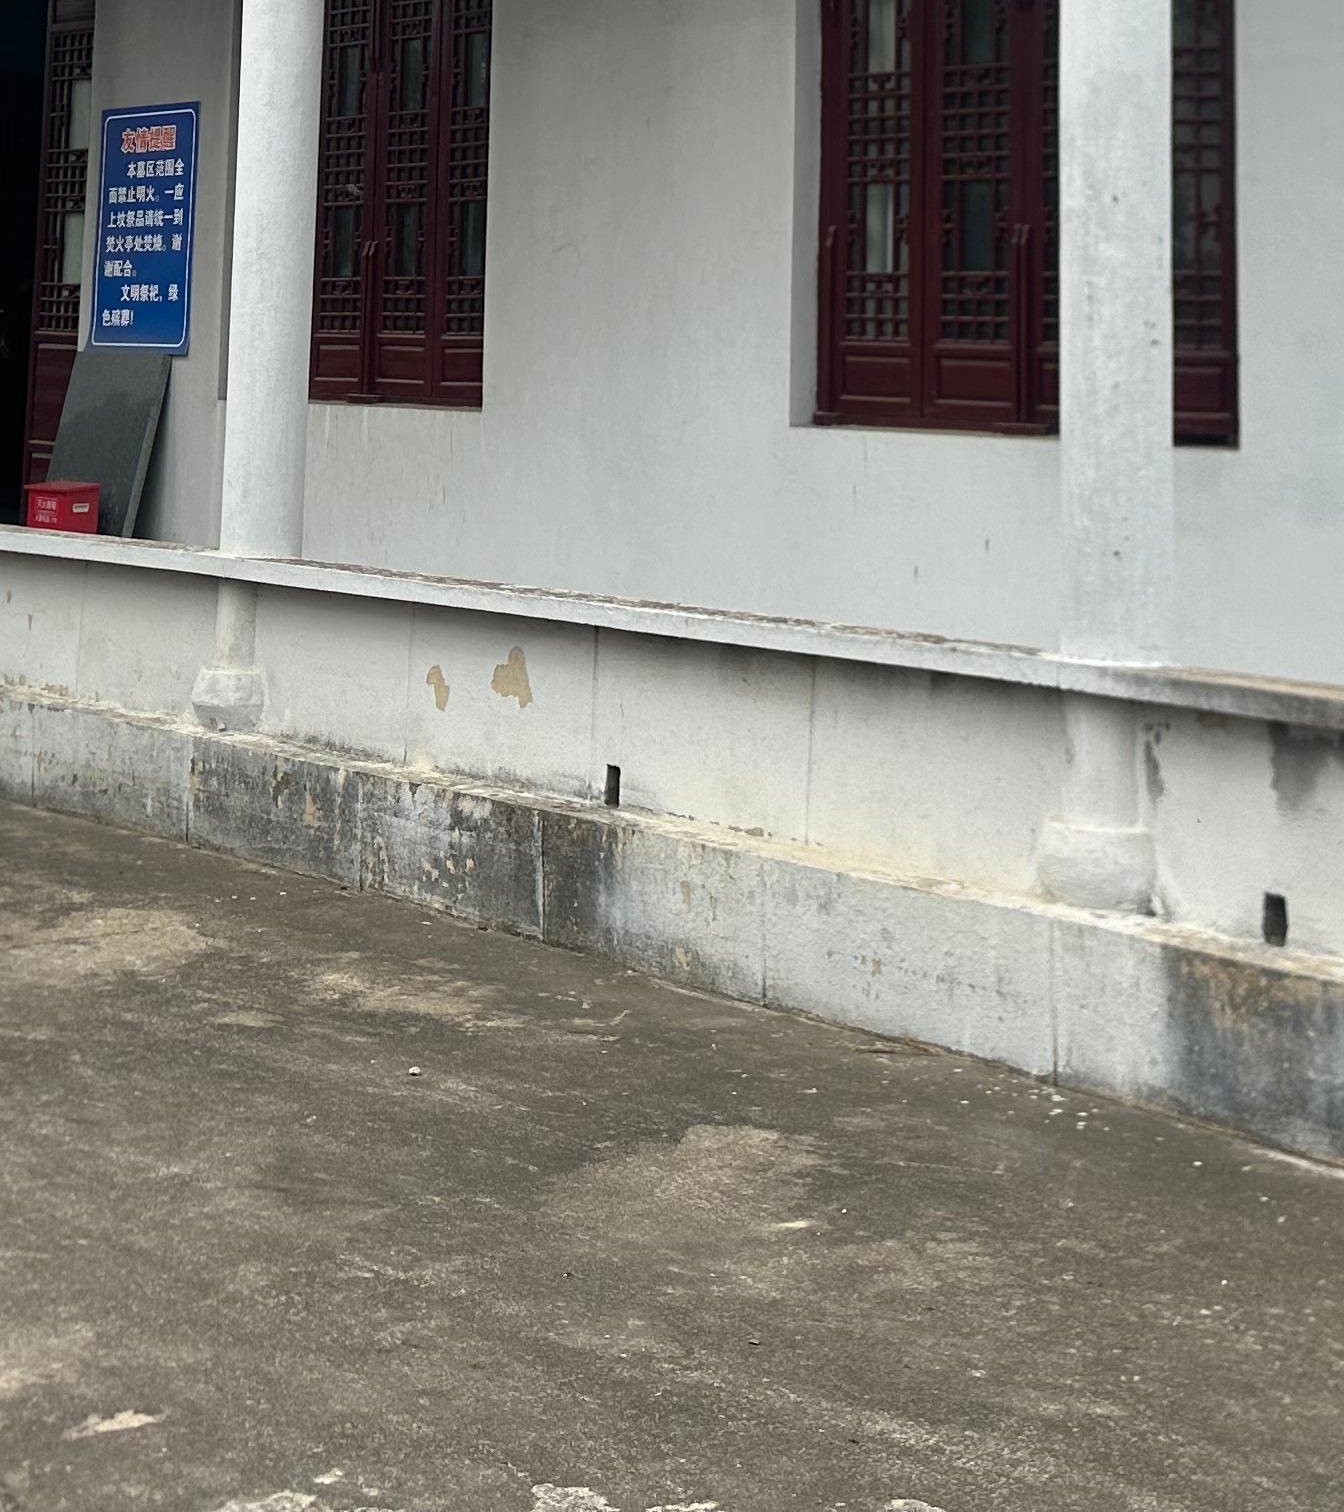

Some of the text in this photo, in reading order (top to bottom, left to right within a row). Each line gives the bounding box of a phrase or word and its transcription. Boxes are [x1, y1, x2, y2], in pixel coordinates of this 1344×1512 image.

[121, 125, 176, 153] 友情提醒
[127, 158, 184, 179] 本墓区范围全
[107, 208, 183, 228] 上坟祭品请统一到
